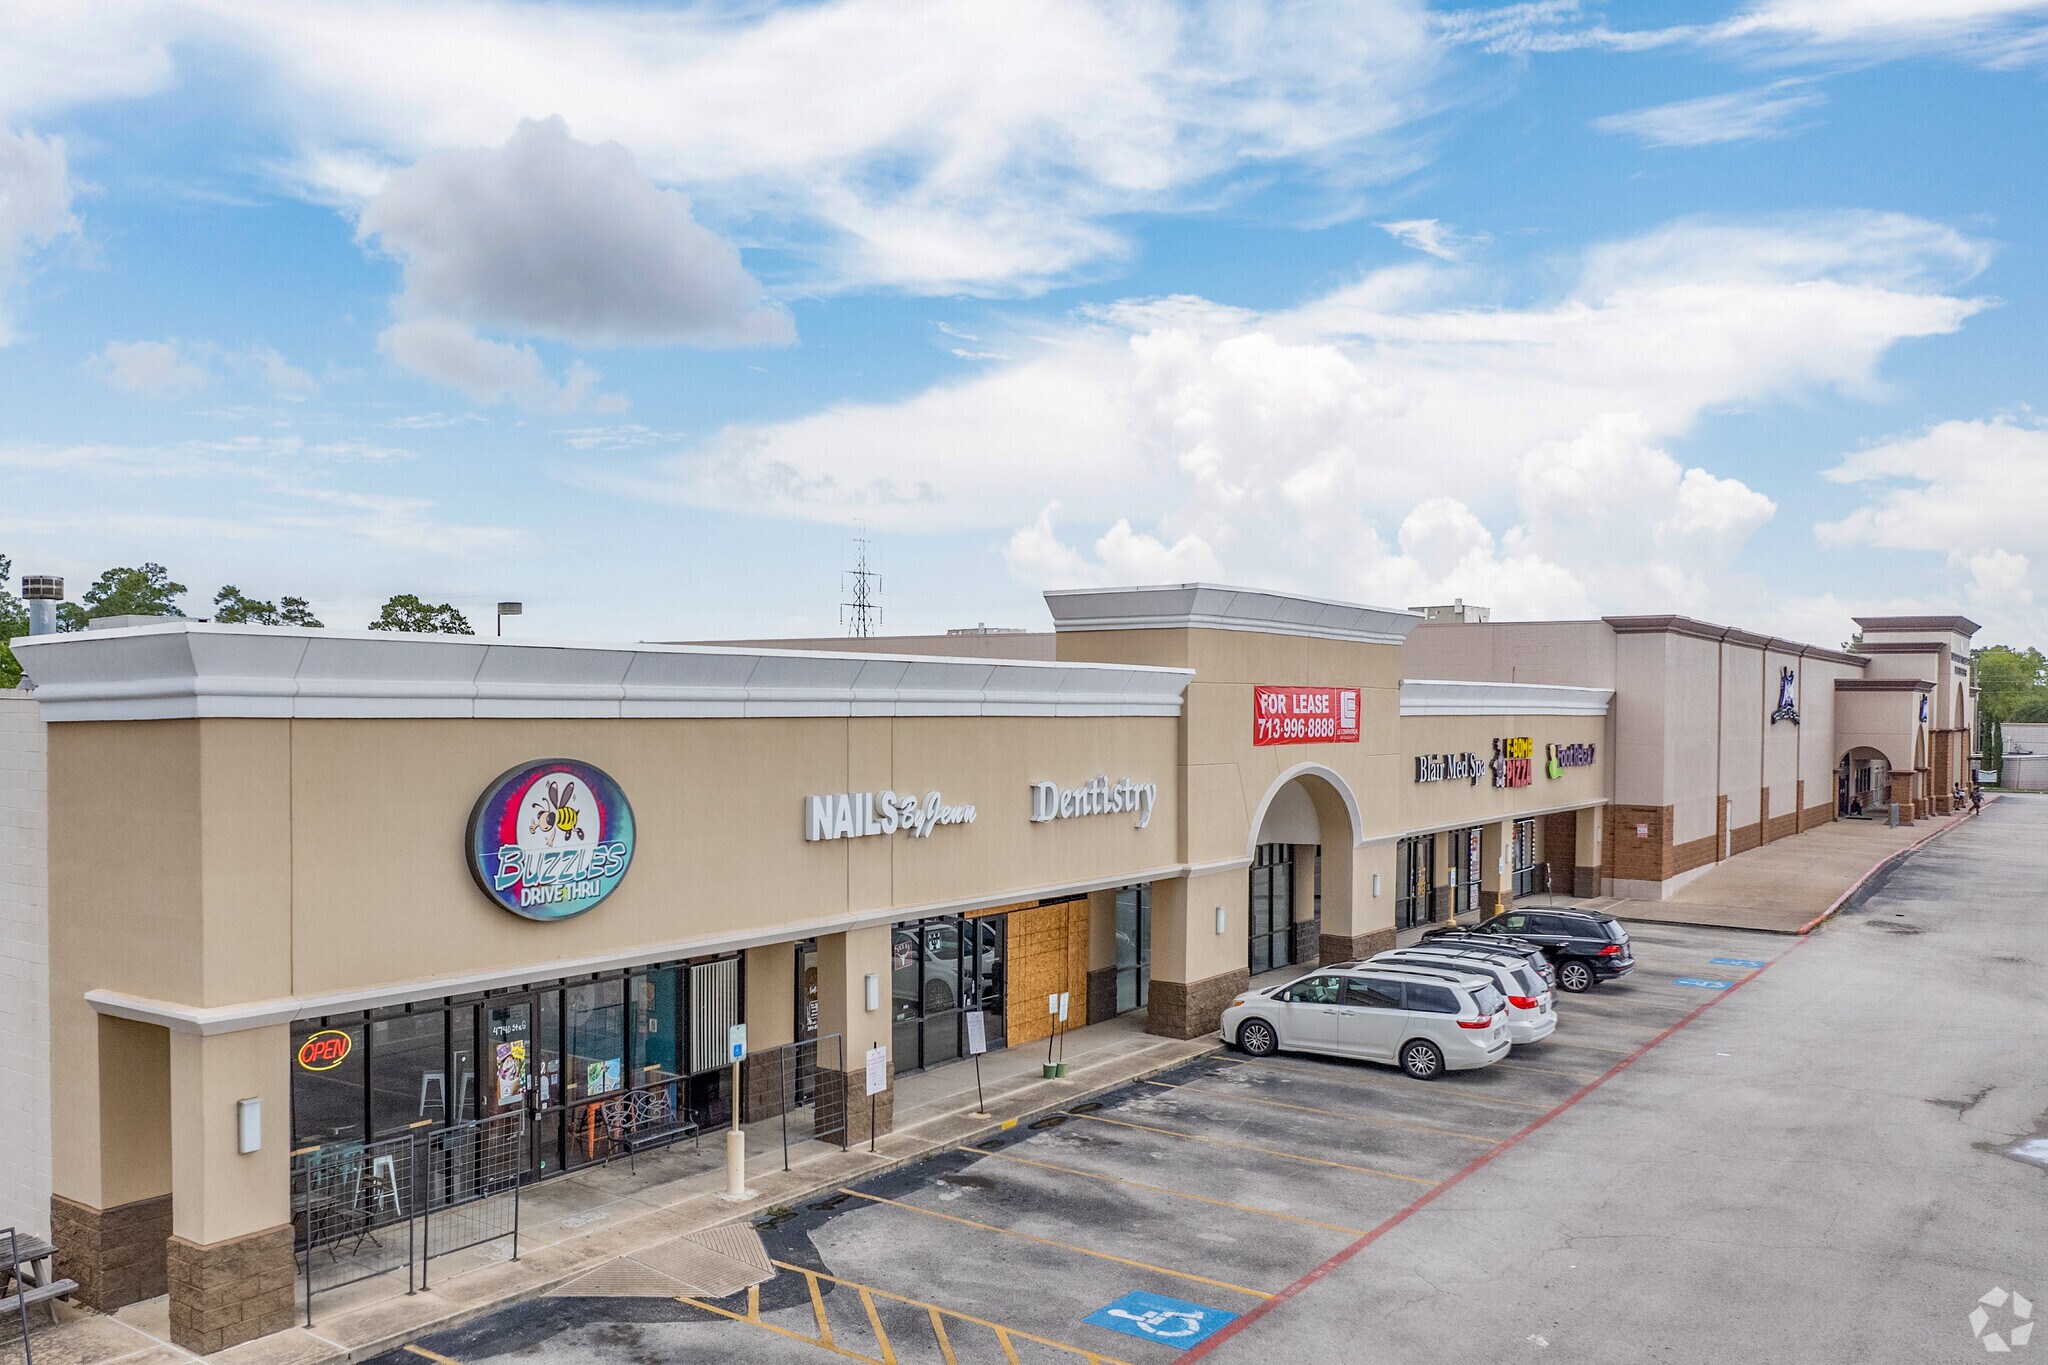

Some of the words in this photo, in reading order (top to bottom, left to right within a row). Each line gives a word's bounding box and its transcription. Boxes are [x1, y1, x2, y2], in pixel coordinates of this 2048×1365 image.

[1261, 693, 1287, 714] FOR
[1293, 694, 1330, 714] LEASE
[1416, 754, 1446, 783] Blair
[1446, 753, 1469, 780] Med
[1470, 752, 1486, 786] Spa
[1505, 759, 1532, 787] PIZZA
[806, 791, 898, 841] NAILS
[899, 795, 924, 838] By
[922, 791, 977, 838] Jenn
[1030, 773, 1157, 829] Dentistry
[494, 842, 627, 891] BUZZLES
[520, 884, 564, 908] DRIVE
[563, 880, 601, 904] THRU
[301, 1037, 348, 1064] OPEN
